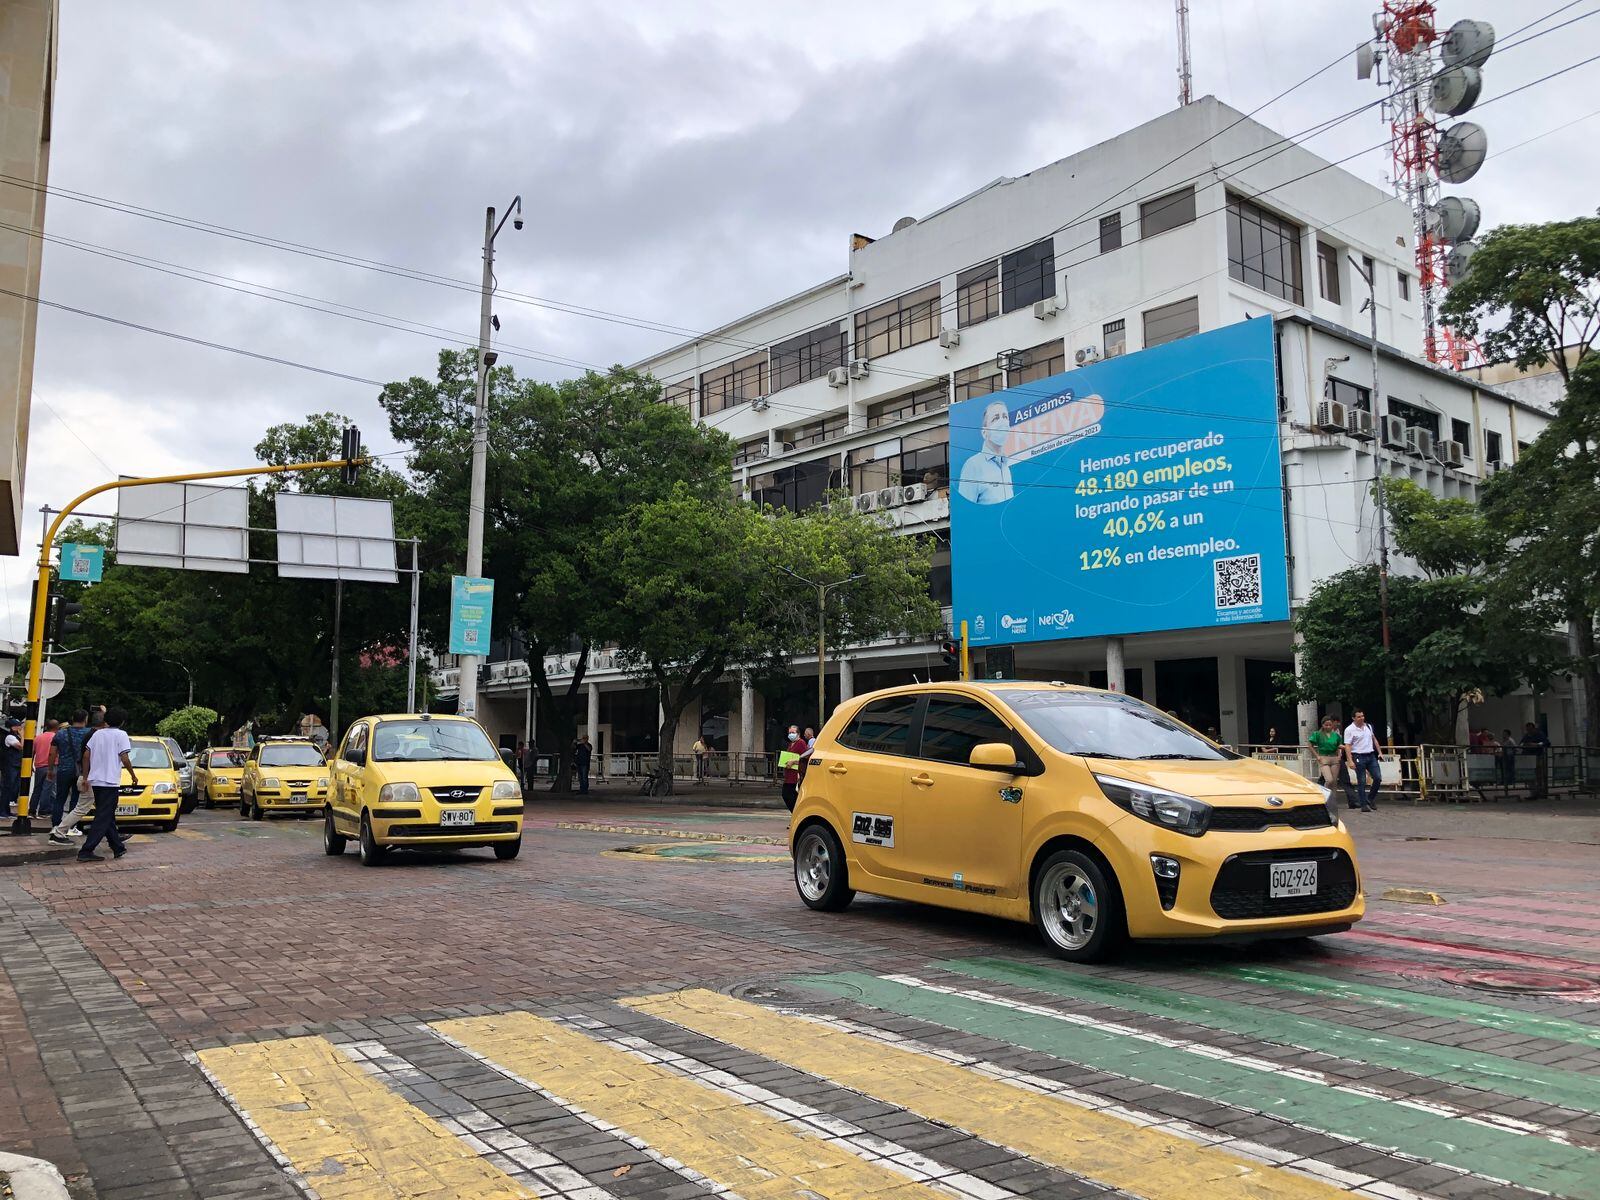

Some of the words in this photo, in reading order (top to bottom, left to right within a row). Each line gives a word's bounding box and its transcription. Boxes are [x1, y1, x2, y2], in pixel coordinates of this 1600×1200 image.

[1013, 402, 1097, 449] NEIVA
[1015, 406, 1032, 423] Así
[1034, 392, 1072, 415] vamos
[1056, 438, 1063, 446] de
[1084, 426, 1099, 436] 2021
[1080, 453, 1131, 473] Hemos
[1134, 431, 1224, 463] recuperado
[1075, 469, 1139, 497] 48.180
[1143, 455, 1233, 484] empleos,
[1075, 495, 1139, 519] logrando
[1143, 489, 1185, 509] pasar
[1188, 482, 1209, 499] de
[1213, 479, 1234, 495] un
[1102, 510, 1166, 538] 40,6%
[1169, 516, 1179, 529] a
[1183, 512, 1204, 526] un
[1079, 546, 1122, 571] 12%
[1125, 551, 1144, 564] en
[1147, 537, 1241, 562] desempleo.
